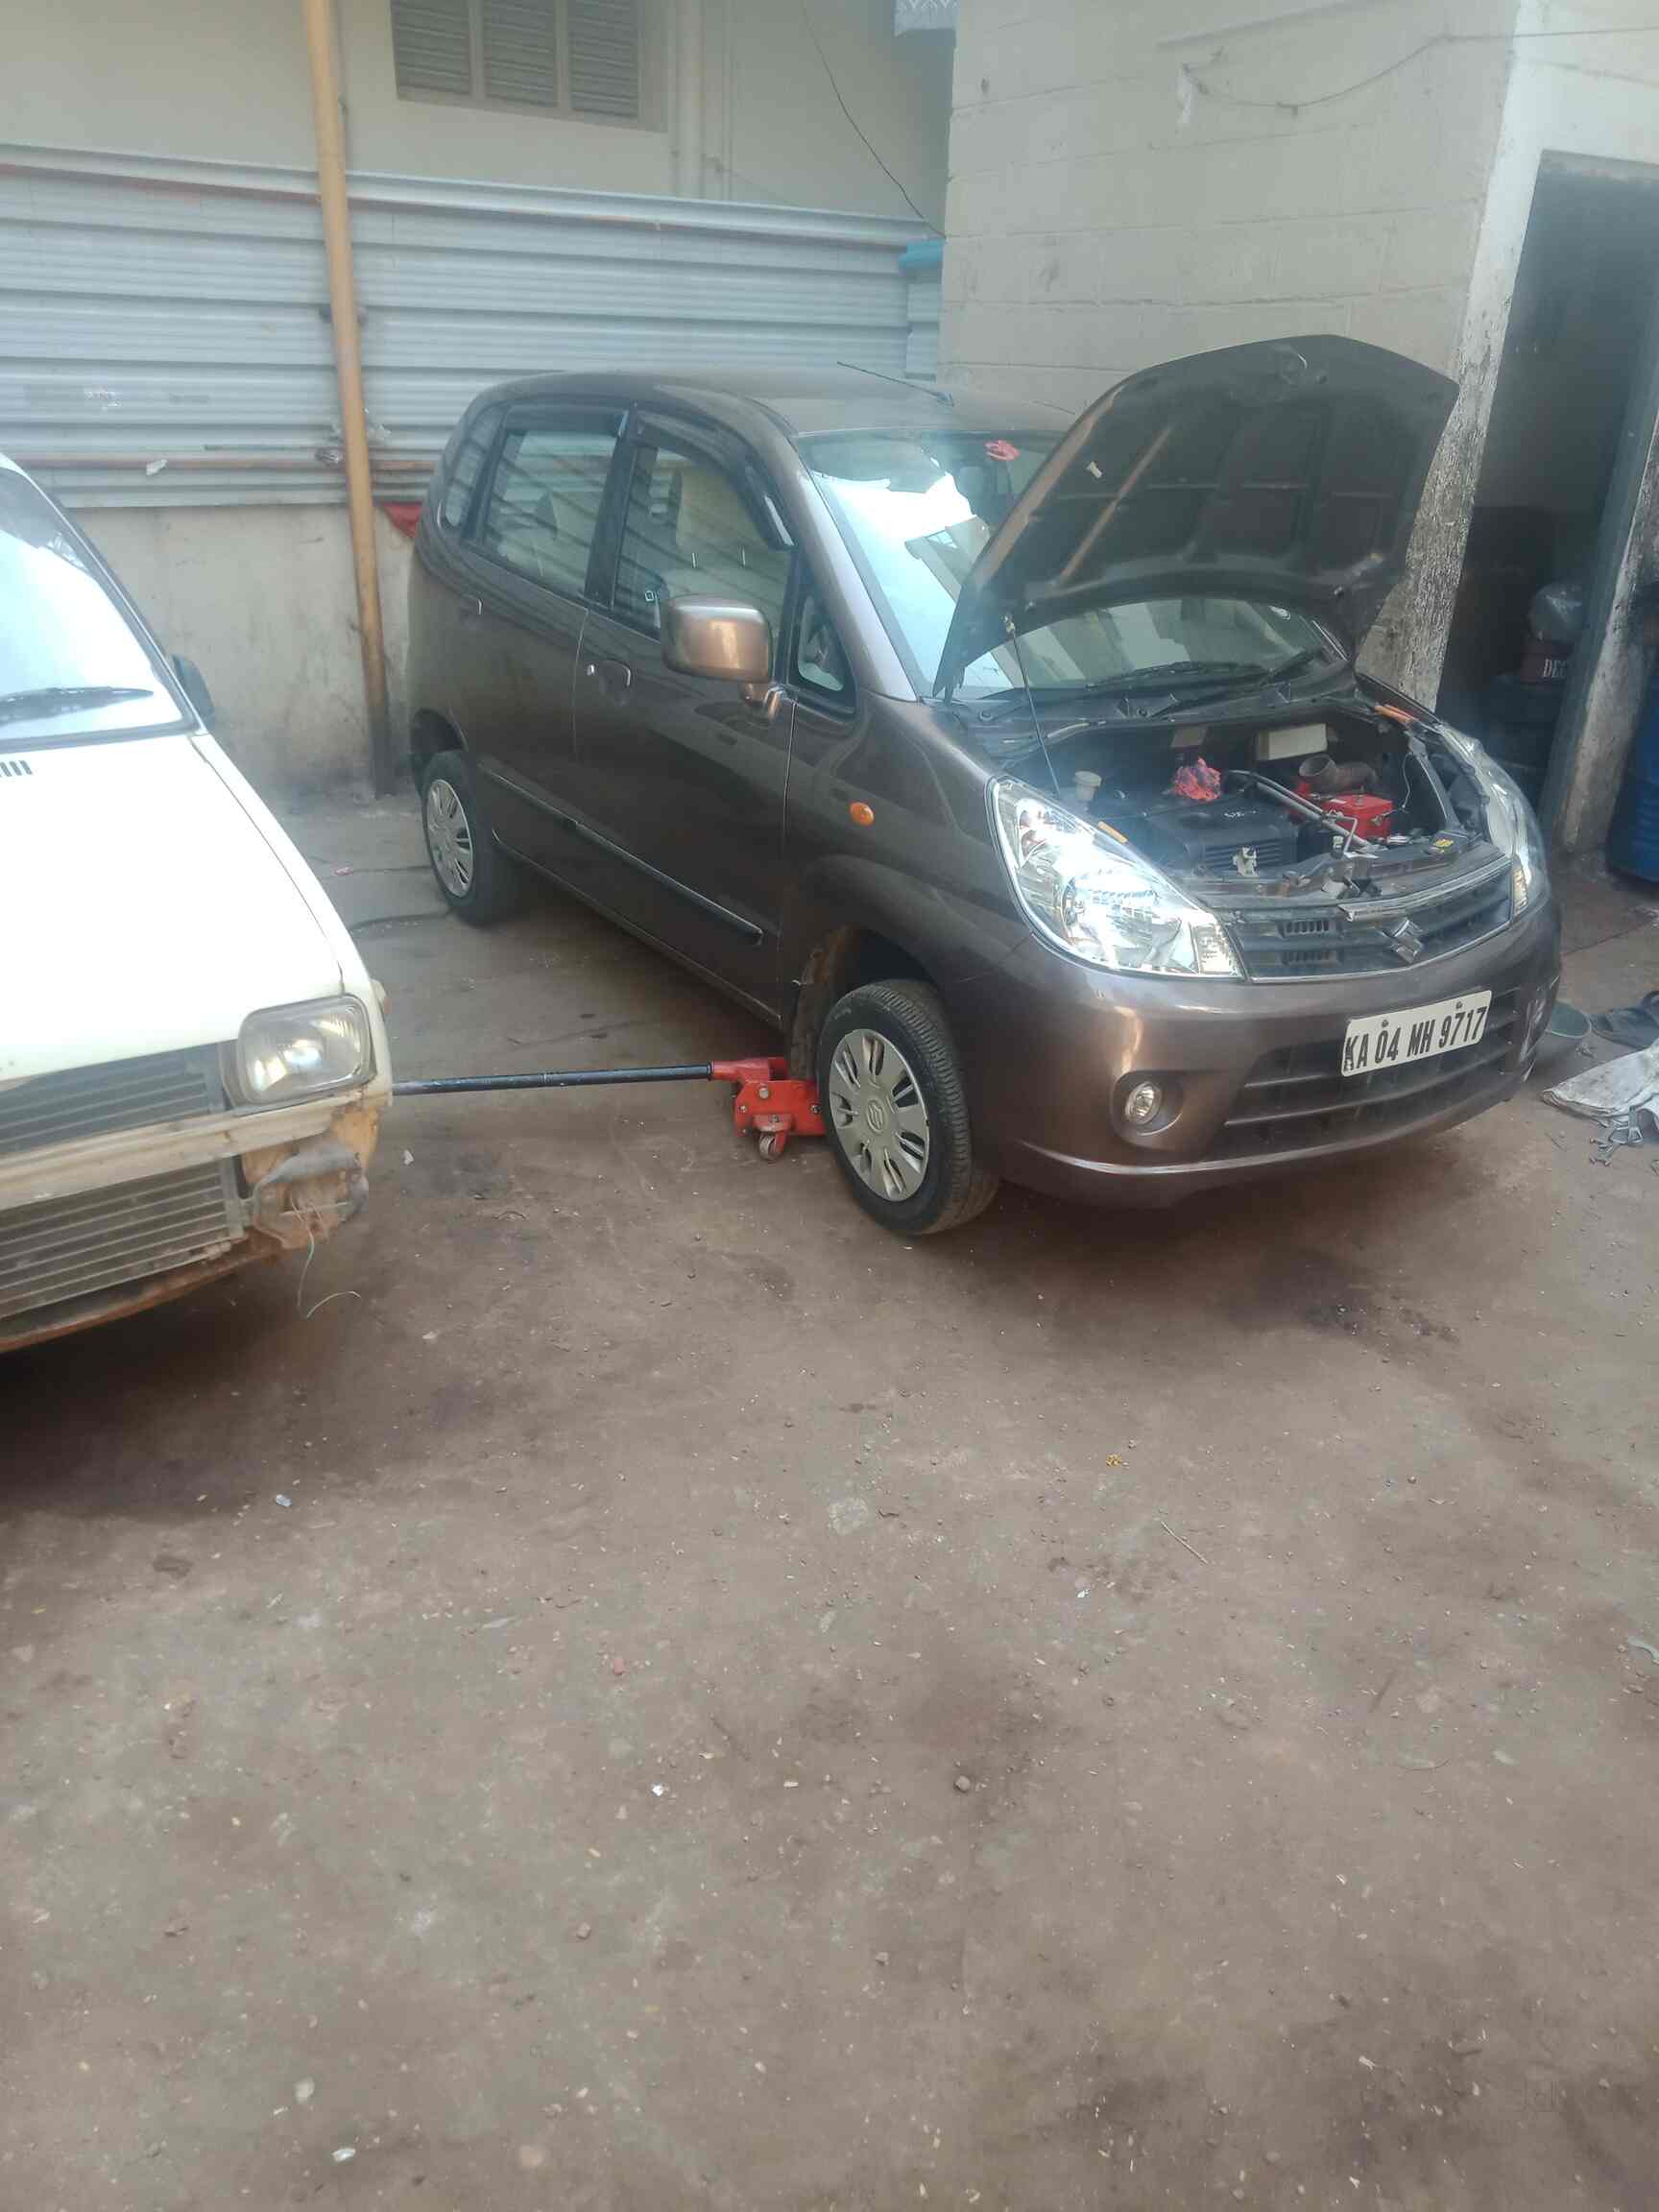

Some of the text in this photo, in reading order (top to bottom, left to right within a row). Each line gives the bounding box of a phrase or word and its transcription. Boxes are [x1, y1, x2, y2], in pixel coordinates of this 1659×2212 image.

[1344, 1006, 1488, 1070] KA 04 MH 9717
